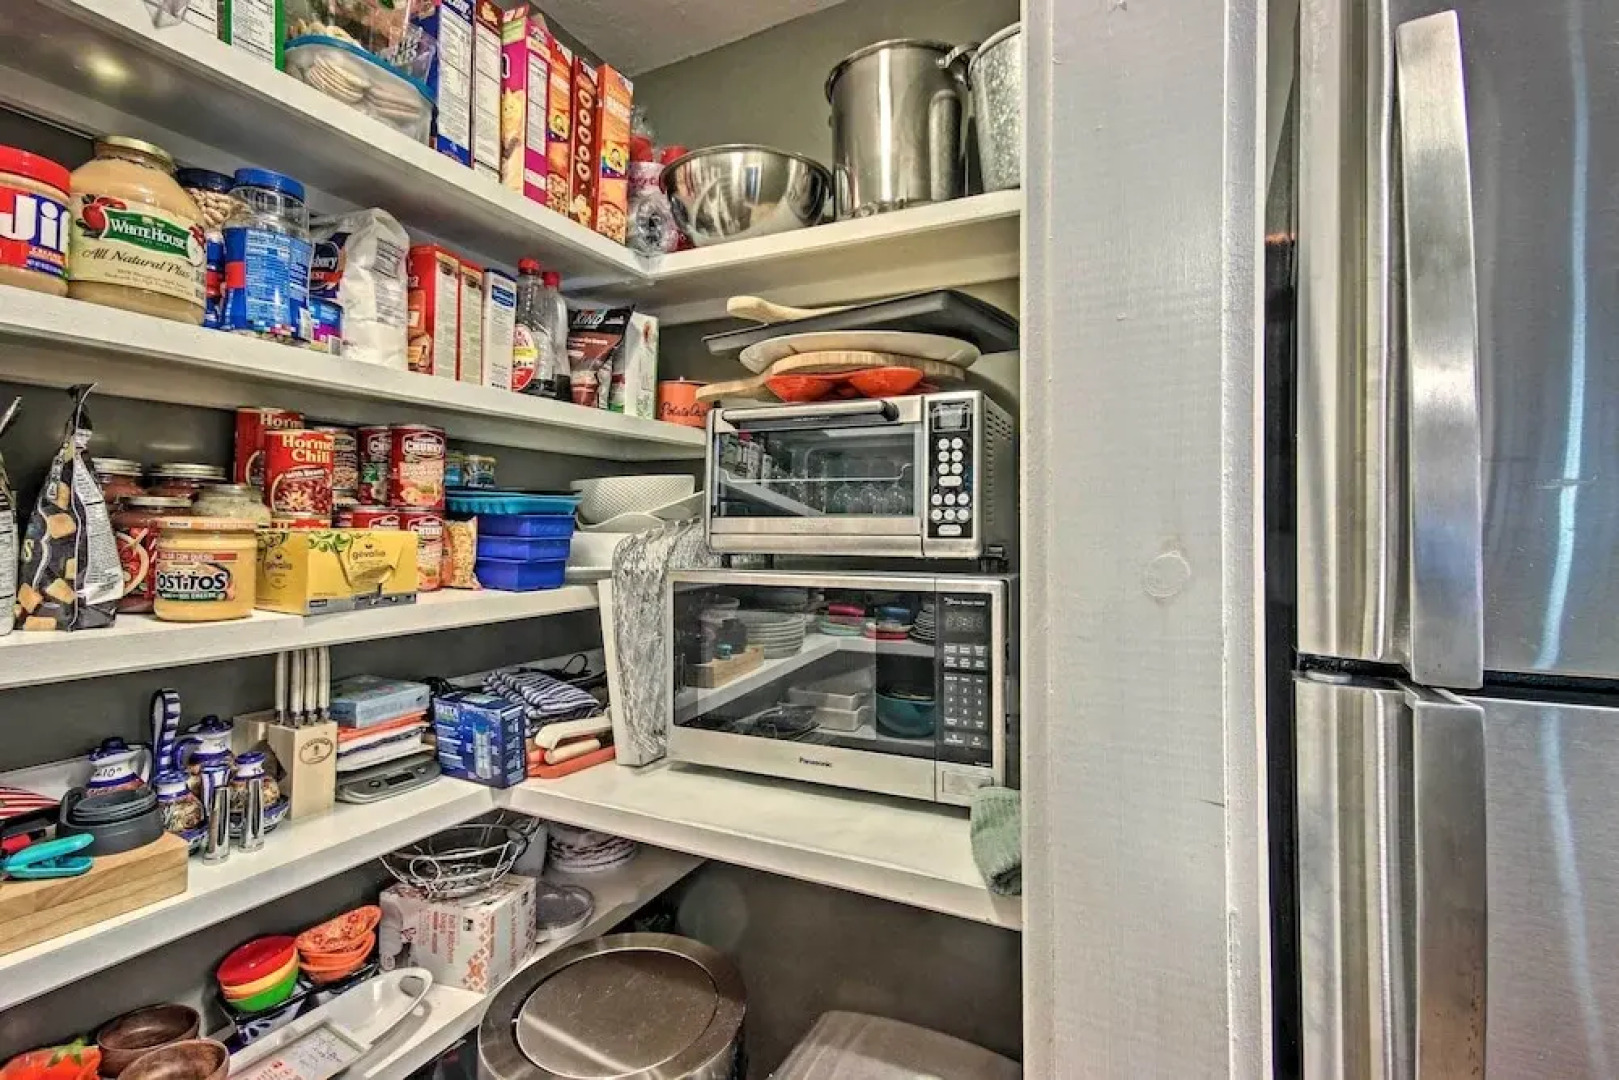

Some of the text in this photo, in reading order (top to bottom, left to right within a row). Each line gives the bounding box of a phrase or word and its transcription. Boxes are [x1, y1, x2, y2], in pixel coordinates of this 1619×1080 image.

[111, 219, 149, 240] WHITE
[110, 250, 166, 271] Natural
[260, 412, 304, 429] Horm
[282, 434, 335, 451] Horme
[291, 448, 330, 463] Chili
